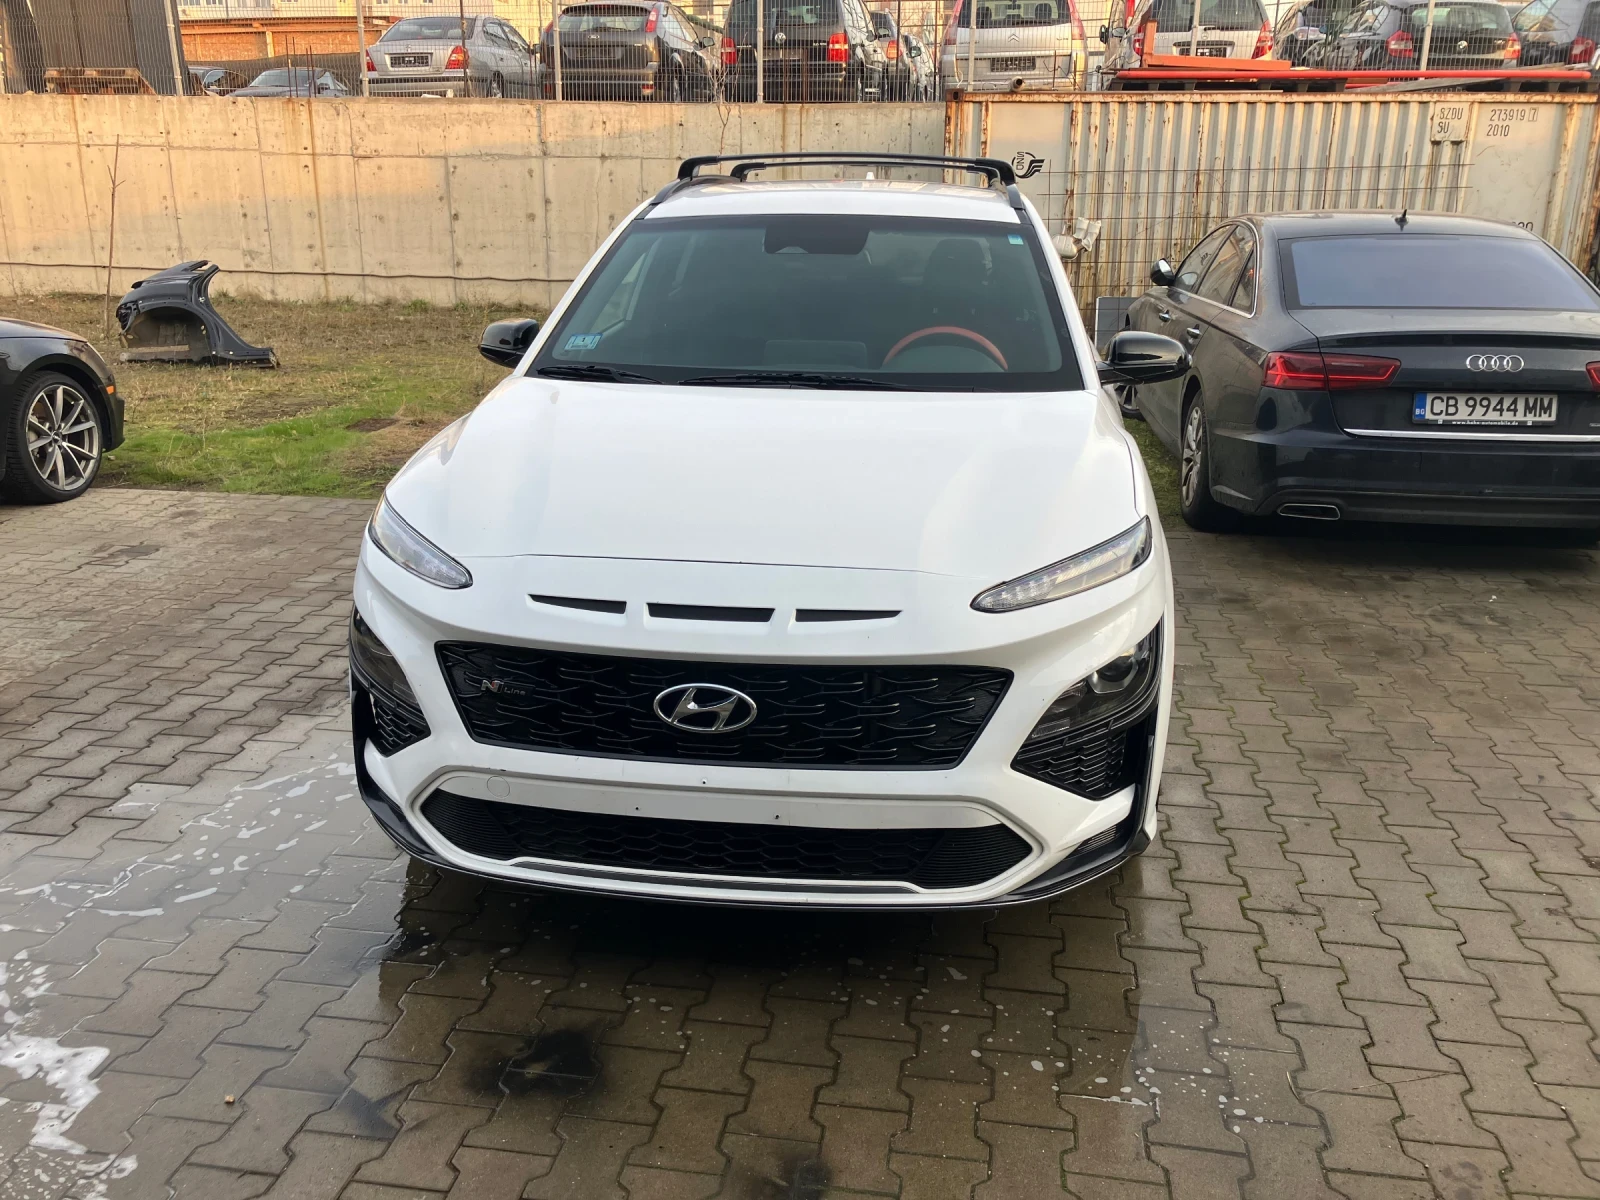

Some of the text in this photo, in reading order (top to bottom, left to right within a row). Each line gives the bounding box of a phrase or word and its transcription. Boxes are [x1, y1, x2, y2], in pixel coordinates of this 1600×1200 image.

[1439, 107, 1464, 120] SZDU
[1489, 108, 1526, 122] 273919
[1437, 121, 1450, 134] SU
[1486, 123, 1510, 137] 2010
[1430, 396, 1553, 418] CB 9944 MM
